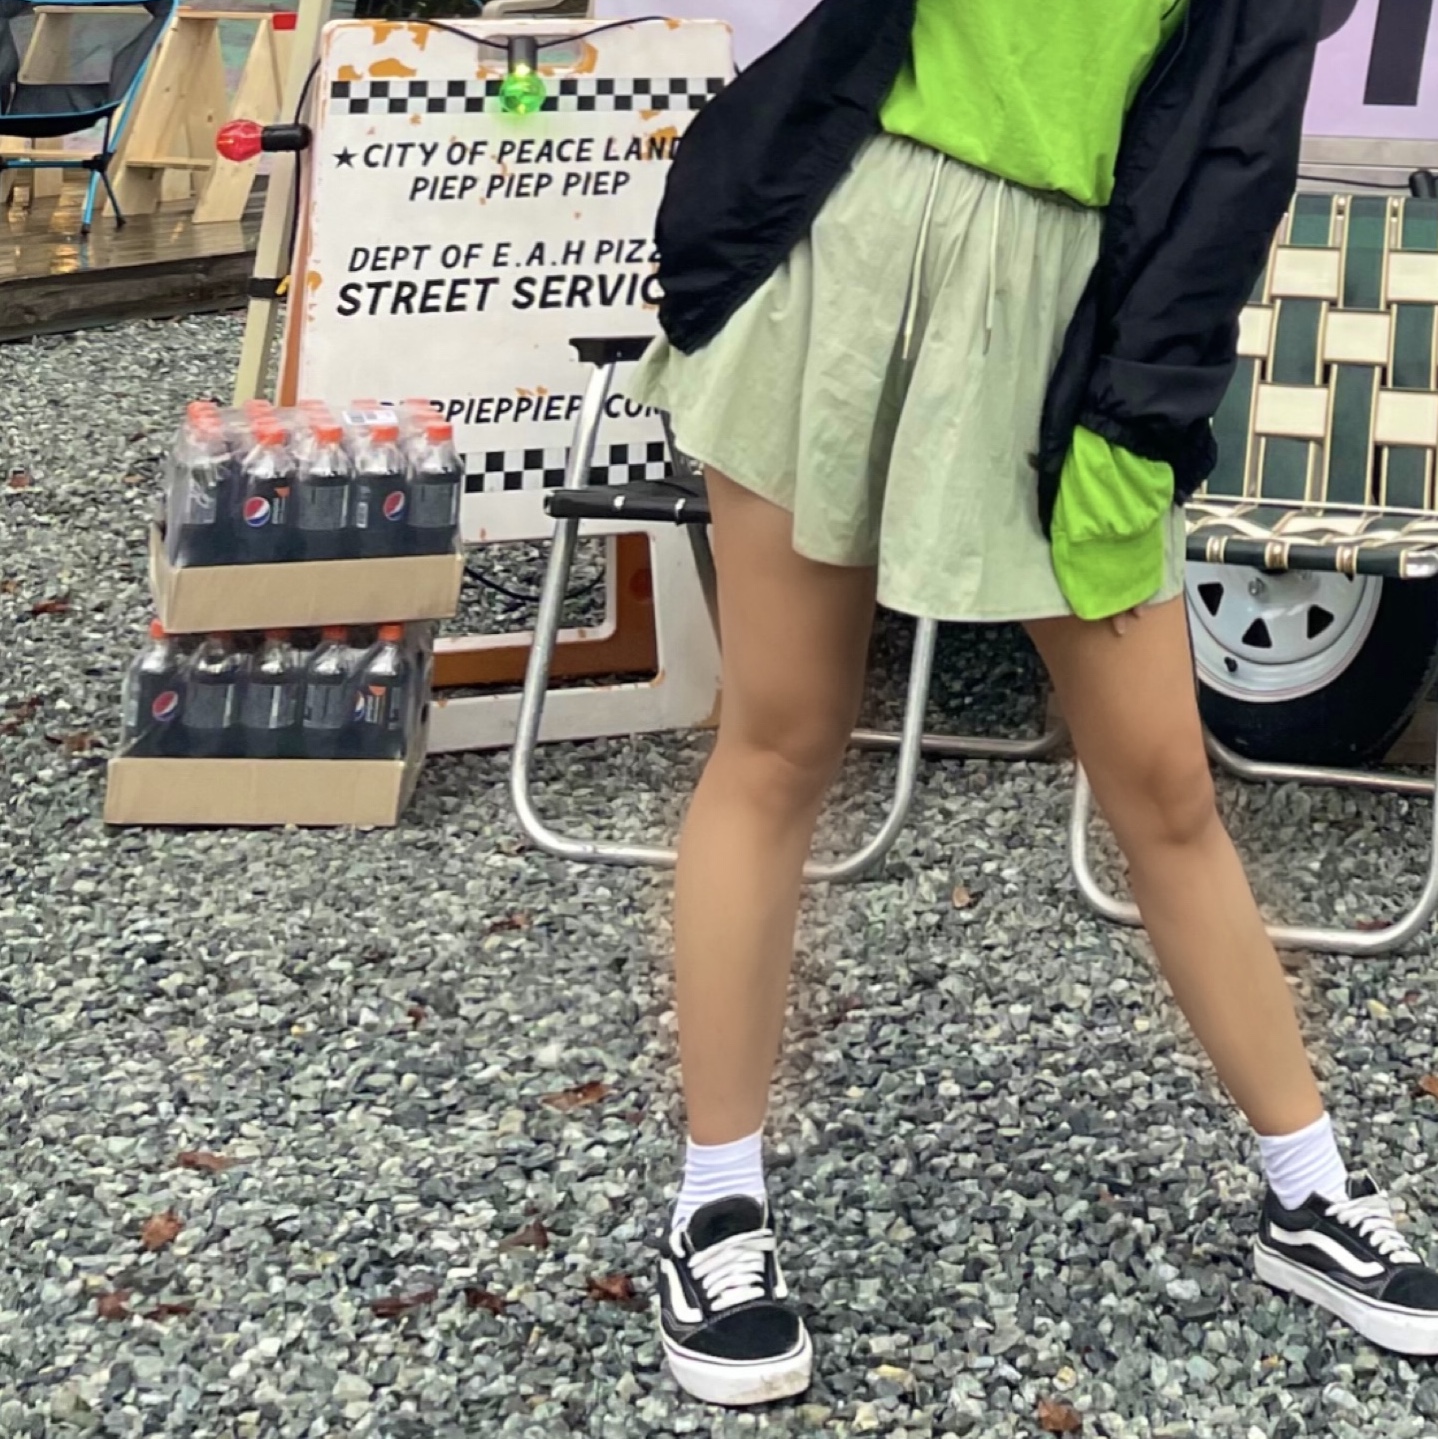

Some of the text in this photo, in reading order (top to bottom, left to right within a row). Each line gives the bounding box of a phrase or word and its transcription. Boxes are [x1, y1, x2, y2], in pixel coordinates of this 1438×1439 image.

[363, 141, 438, 169] CITY
[446, 139, 489, 166] OF
[496, 137, 596, 165] PEACE
[409, 170, 631, 202] PIEP PIEP PIEP
[348, 244, 431, 272] DEPT
[441, 242, 483, 269] OF
[493, 239, 586, 268] E.A.H
[336, 275, 500, 316] STREET
